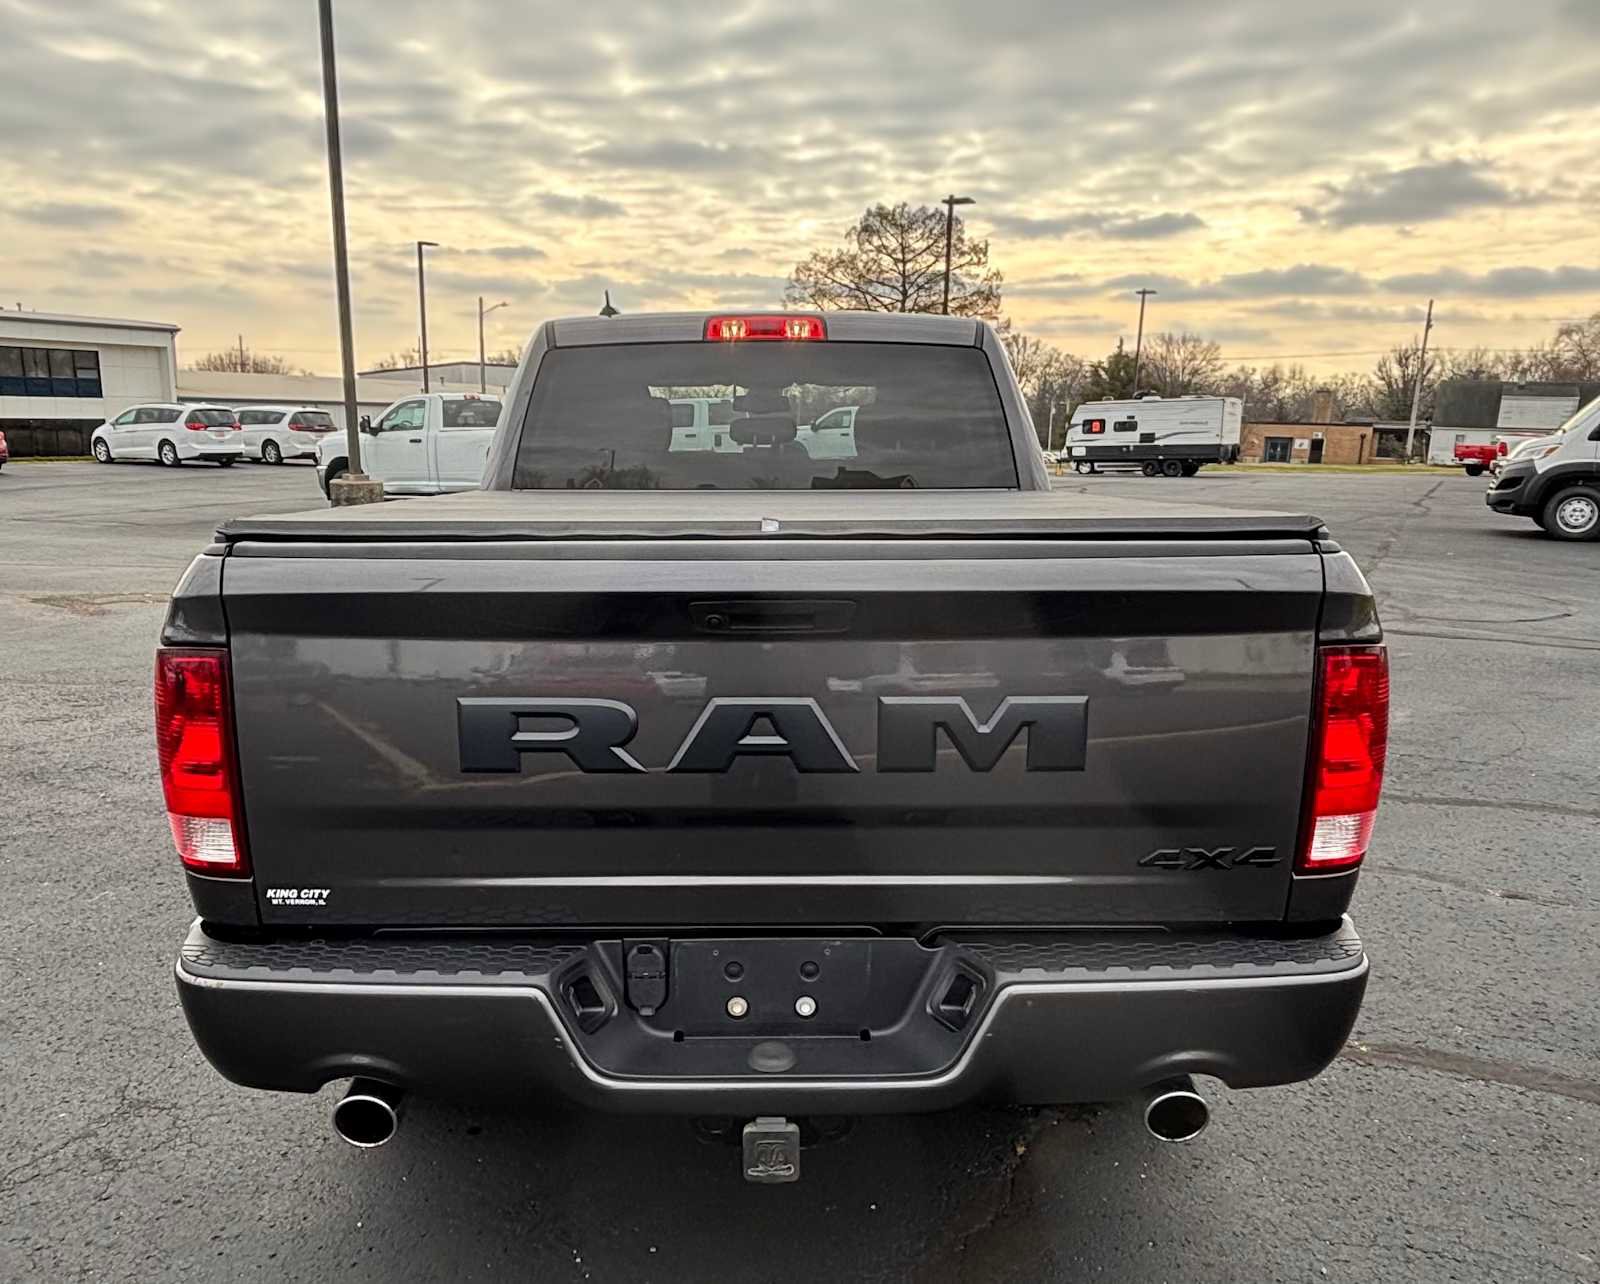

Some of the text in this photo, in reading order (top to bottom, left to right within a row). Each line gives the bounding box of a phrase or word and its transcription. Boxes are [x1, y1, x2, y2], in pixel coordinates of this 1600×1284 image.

[456, 695, 1090, 773] RAM
[266, 888, 331, 898] KING CITY
